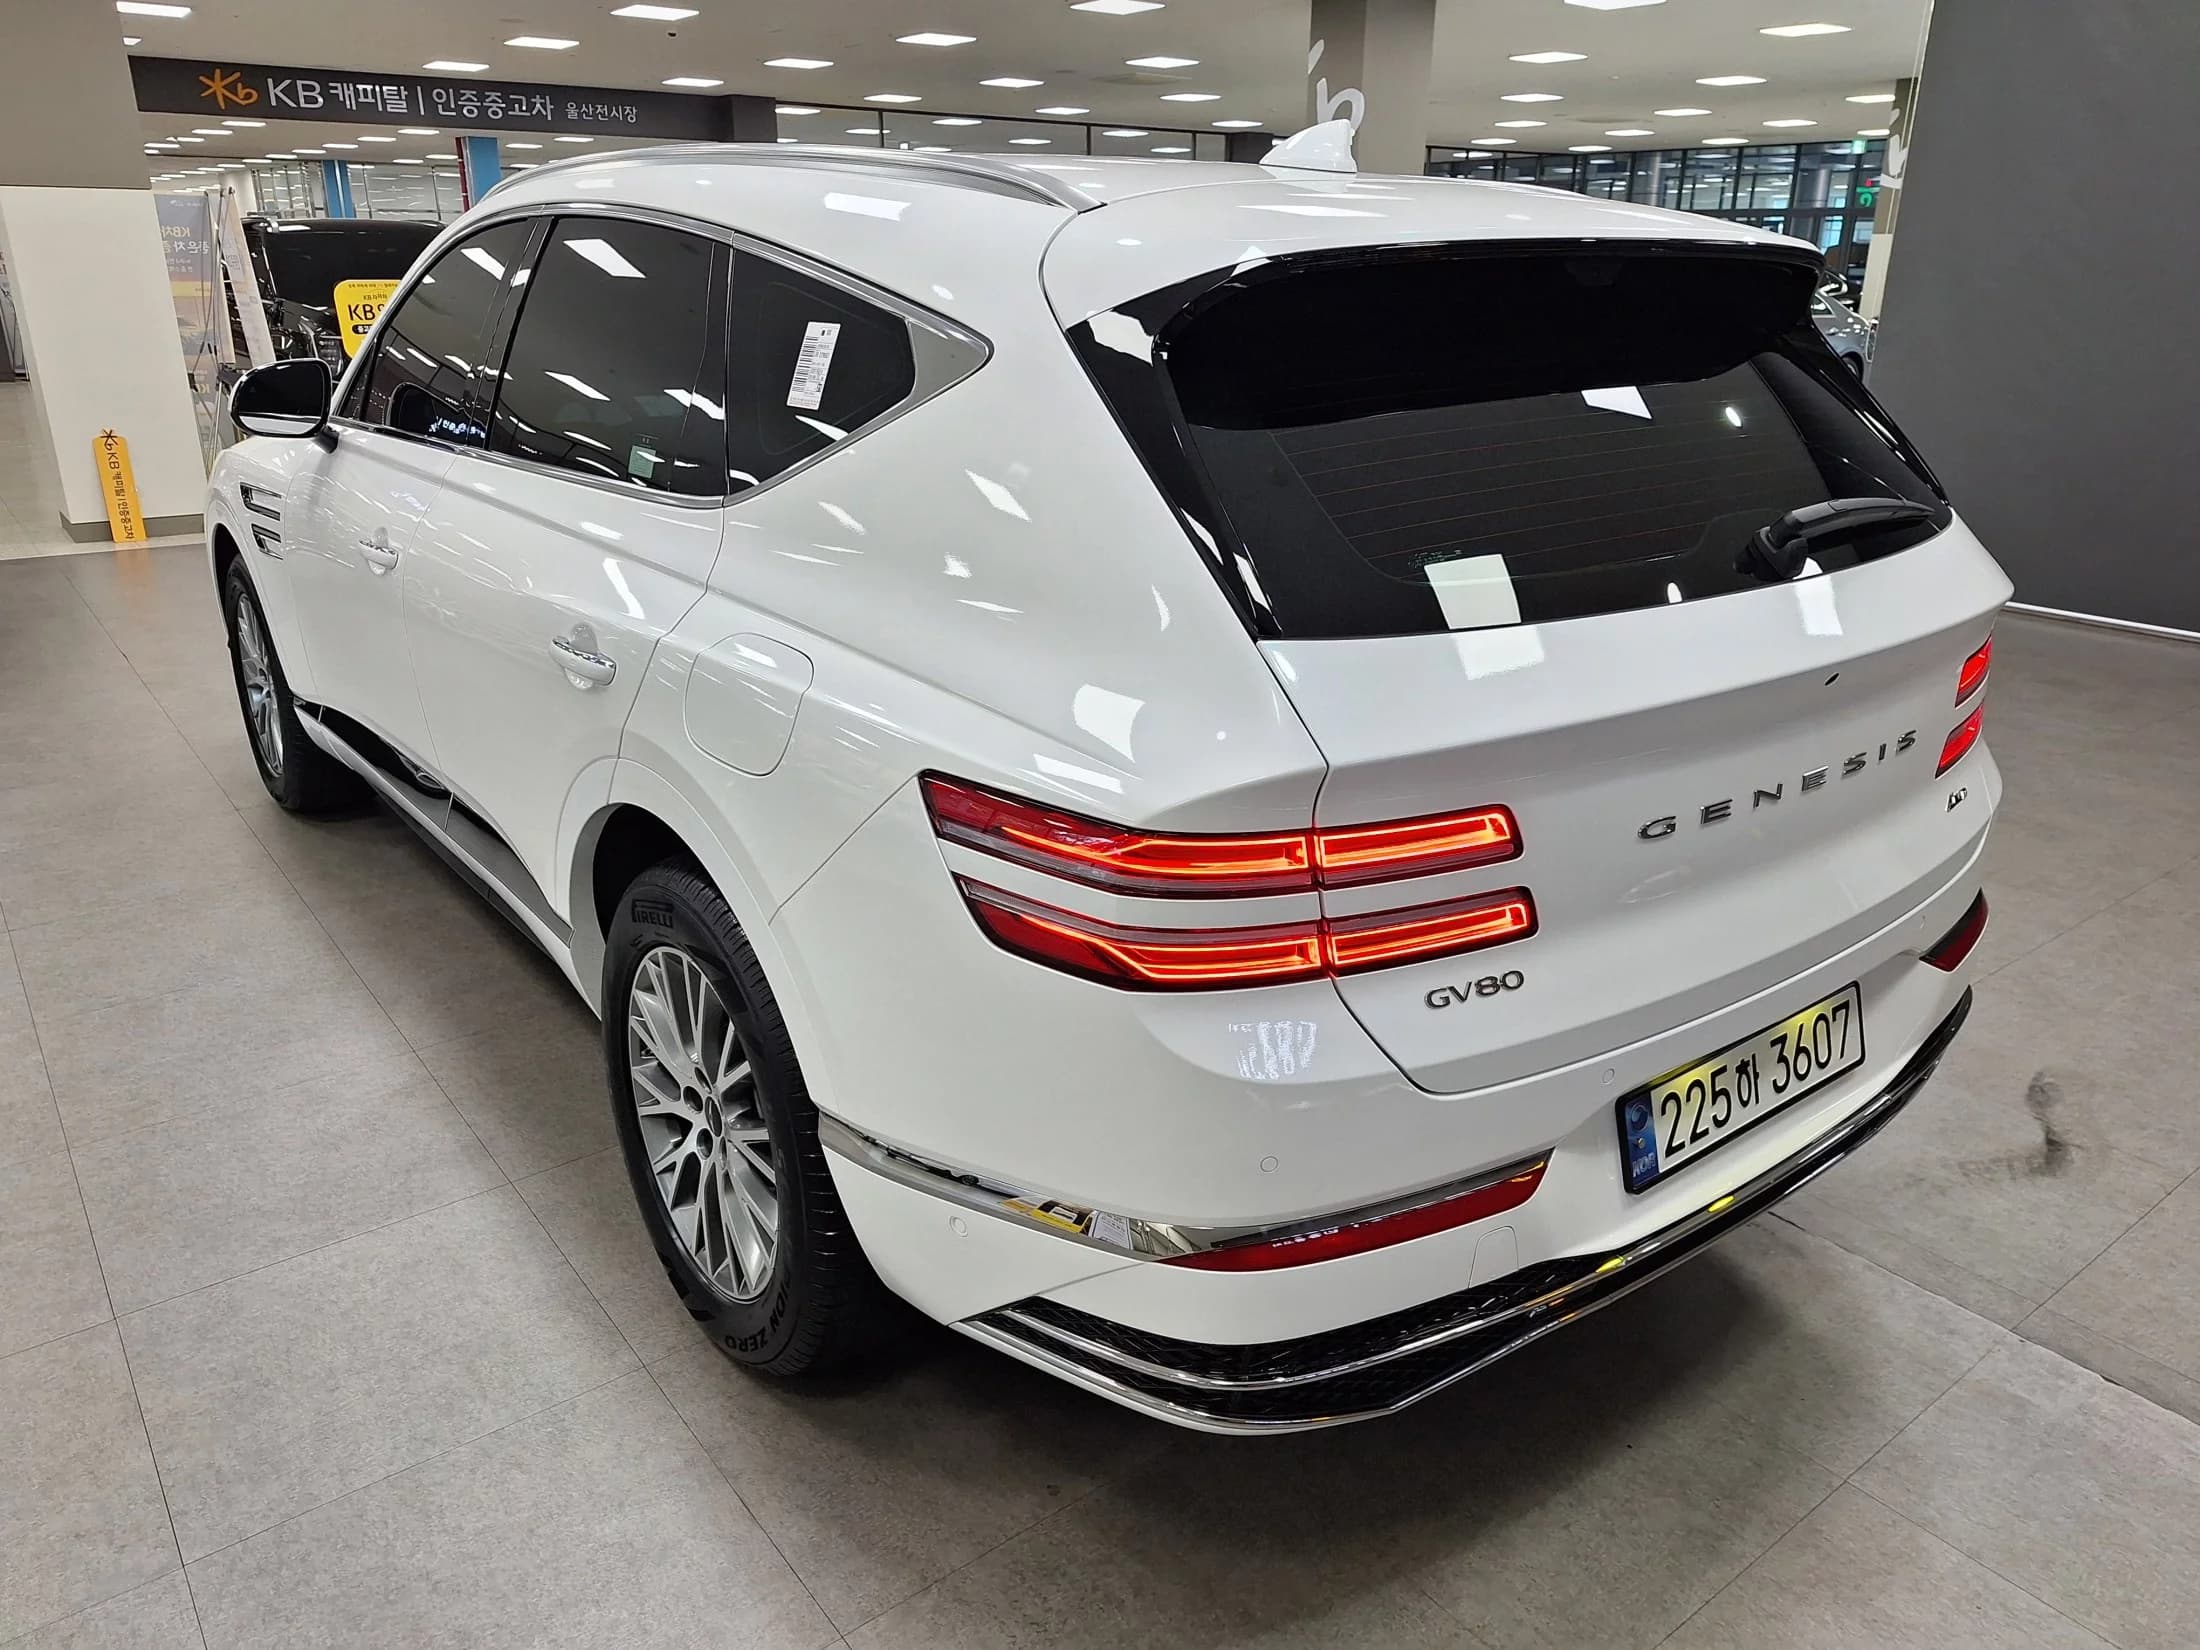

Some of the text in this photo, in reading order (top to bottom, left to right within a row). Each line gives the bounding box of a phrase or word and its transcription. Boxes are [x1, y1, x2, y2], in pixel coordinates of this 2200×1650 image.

[266, 78, 324, 108] KB
[328, 82, 408, 113] 캐피탈
[432, 88, 554, 121] 인증중고차
[565, 101, 638, 123] 울산전시장
[106, 452, 120, 470] KB
[1637, 729, 1917, 840] GENESIS
[631, 899, 674, 929] PIRELLI
[1424, 970, 1525, 1009] GV80
[1660, 999, 1850, 1159] 225하 3607
[725, 1326, 769, 1353] ZERO
